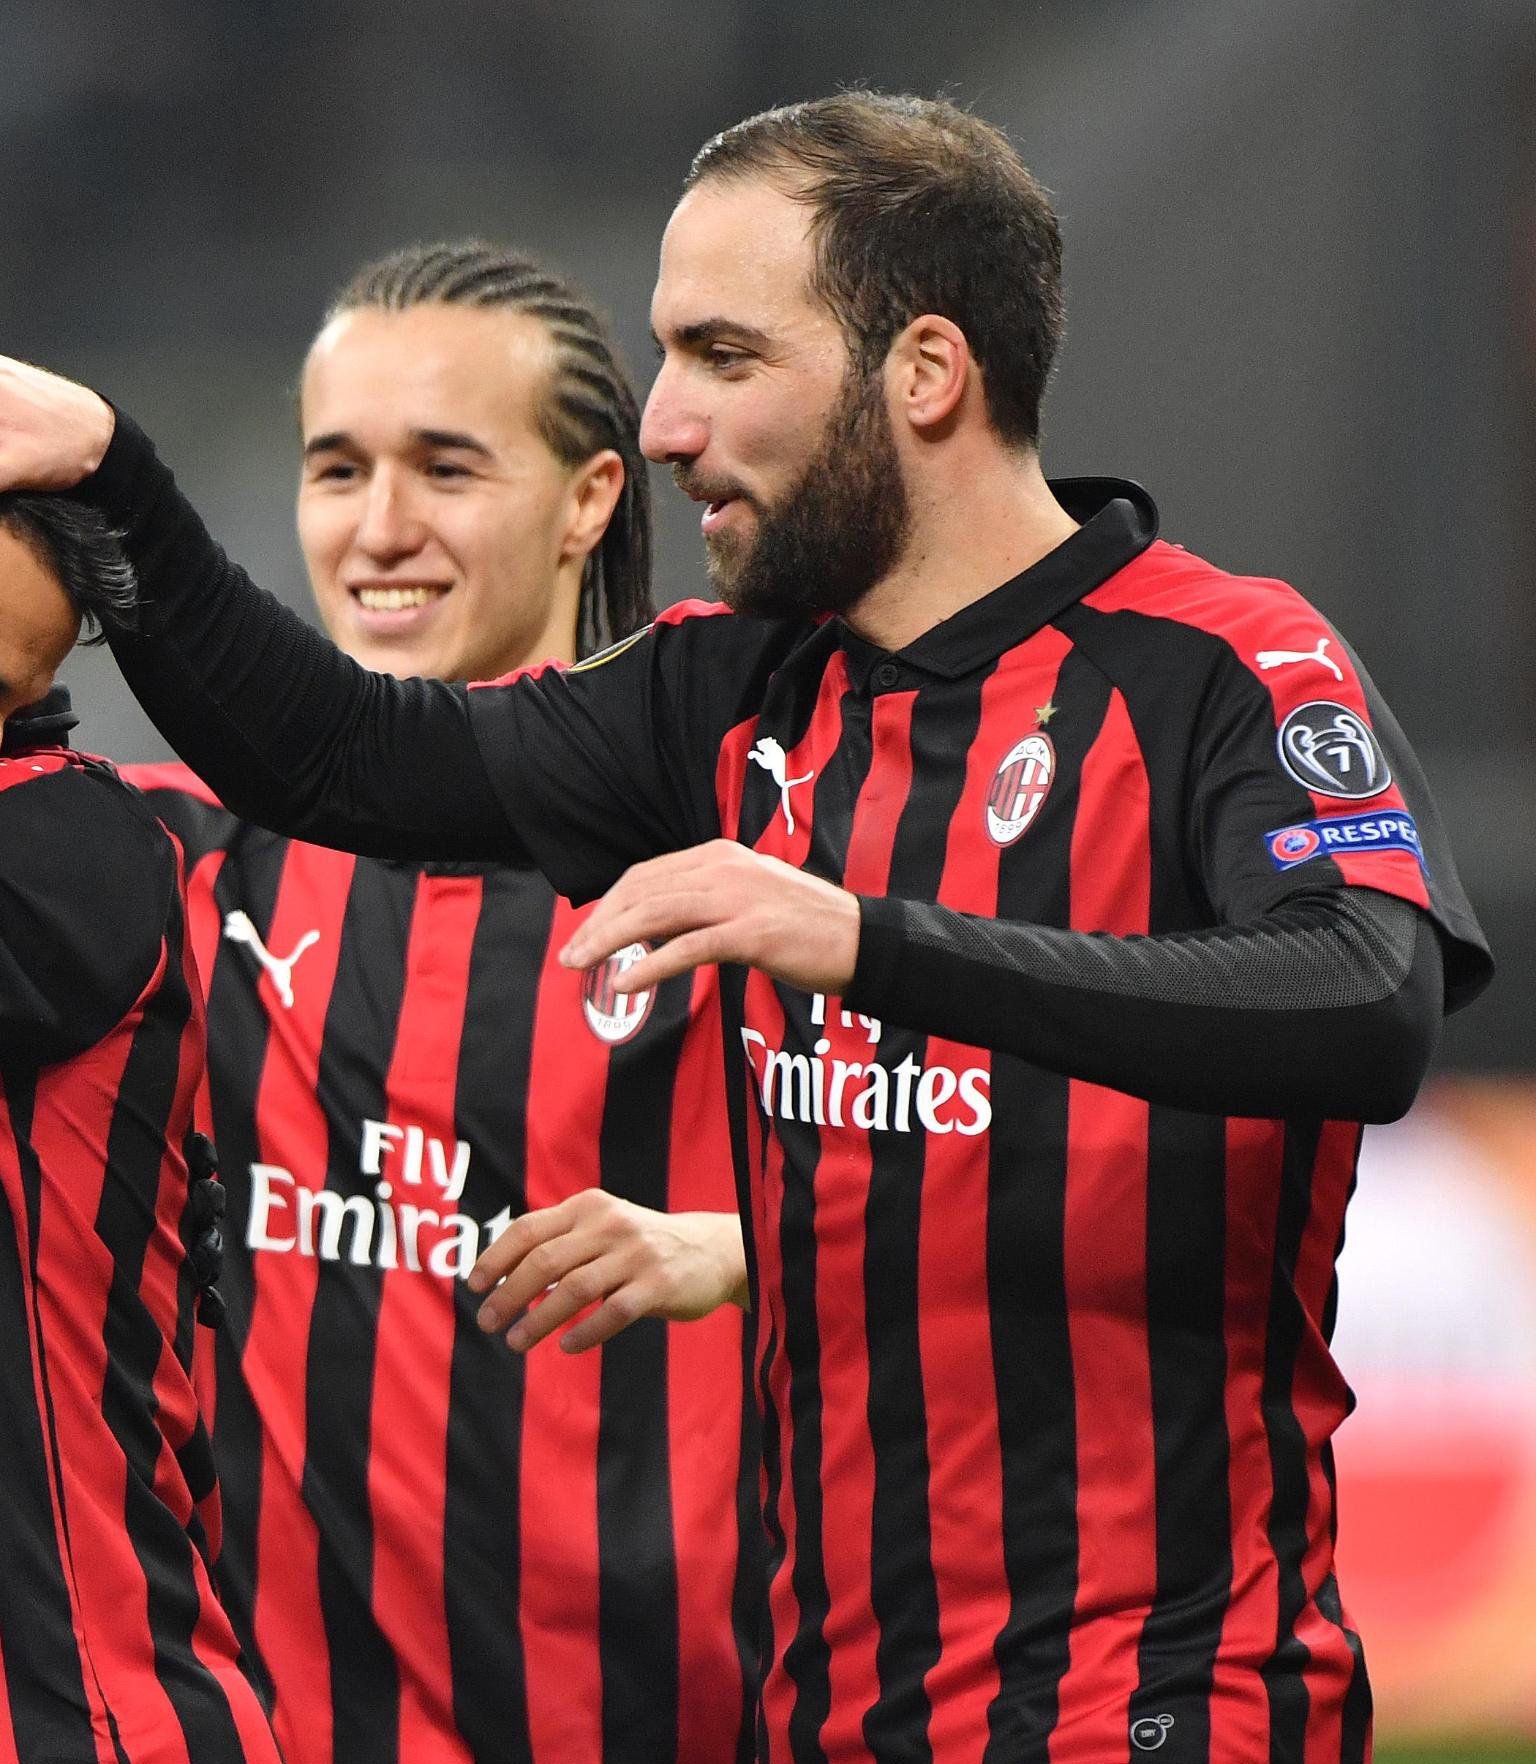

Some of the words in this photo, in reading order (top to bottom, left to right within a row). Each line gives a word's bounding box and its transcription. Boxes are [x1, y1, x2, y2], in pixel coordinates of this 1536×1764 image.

[1326, 746, 1351, 773] 7
[1321, 819, 1422, 845] RESPE
[359, 1118, 471, 1201] Fly
[245, 1161, 512, 1281] Emira
